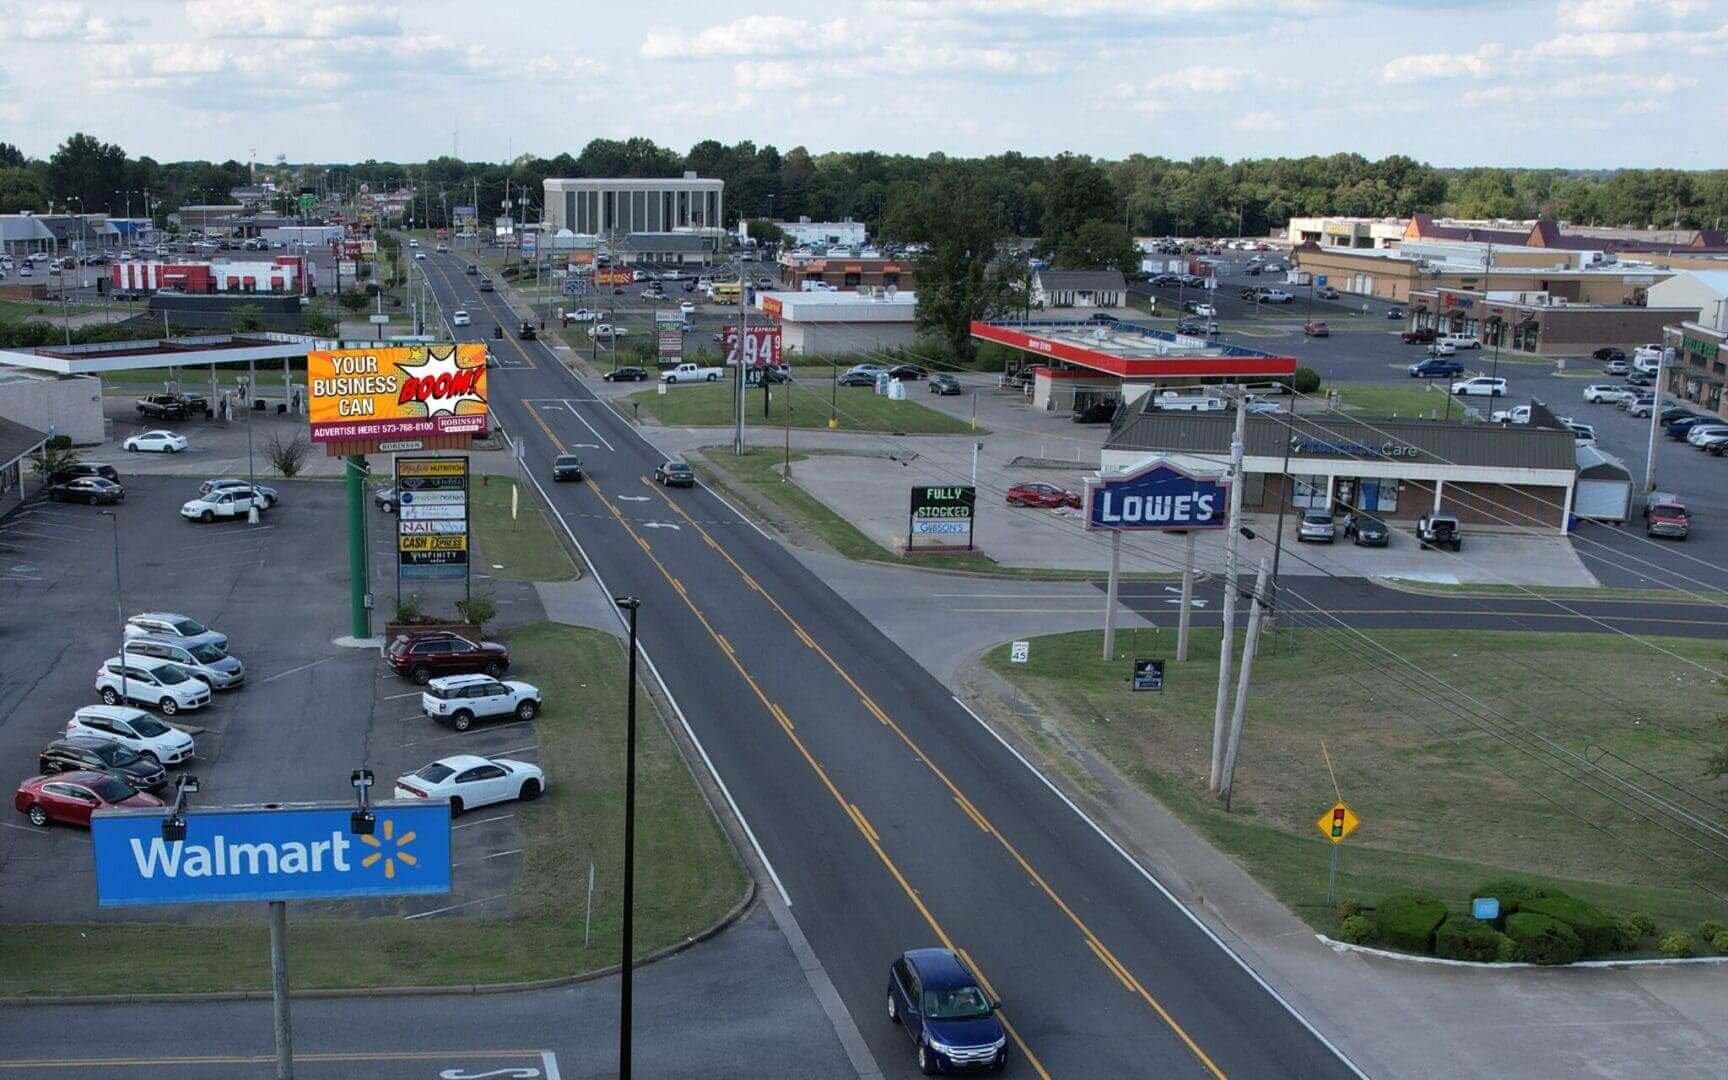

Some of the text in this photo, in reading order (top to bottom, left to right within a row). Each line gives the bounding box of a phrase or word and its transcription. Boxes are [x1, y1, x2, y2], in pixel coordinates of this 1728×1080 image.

[331, 355, 378, 376] YOUR
[313, 376, 397, 397] BUSINESS
[398, 367, 486, 405] BOOM!
[339, 399, 375, 417] CAN
[314, 426, 356, 436] ADVERTISE
[358, 424, 381, 434] HERE!
[1381, 441, 1418, 457] Care
[430, 464, 464, 472] NUTRITION
[927, 488, 962, 500] FULLY
[918, 506, 969, 518] STOCKED
[1102, 491, 1214, 522] LOWE'S
[403, 537, 462, 549] CASH EXPRESS
[1013, 652, 1026, 660] 45
[129, 830, 351, 879] Walmart
